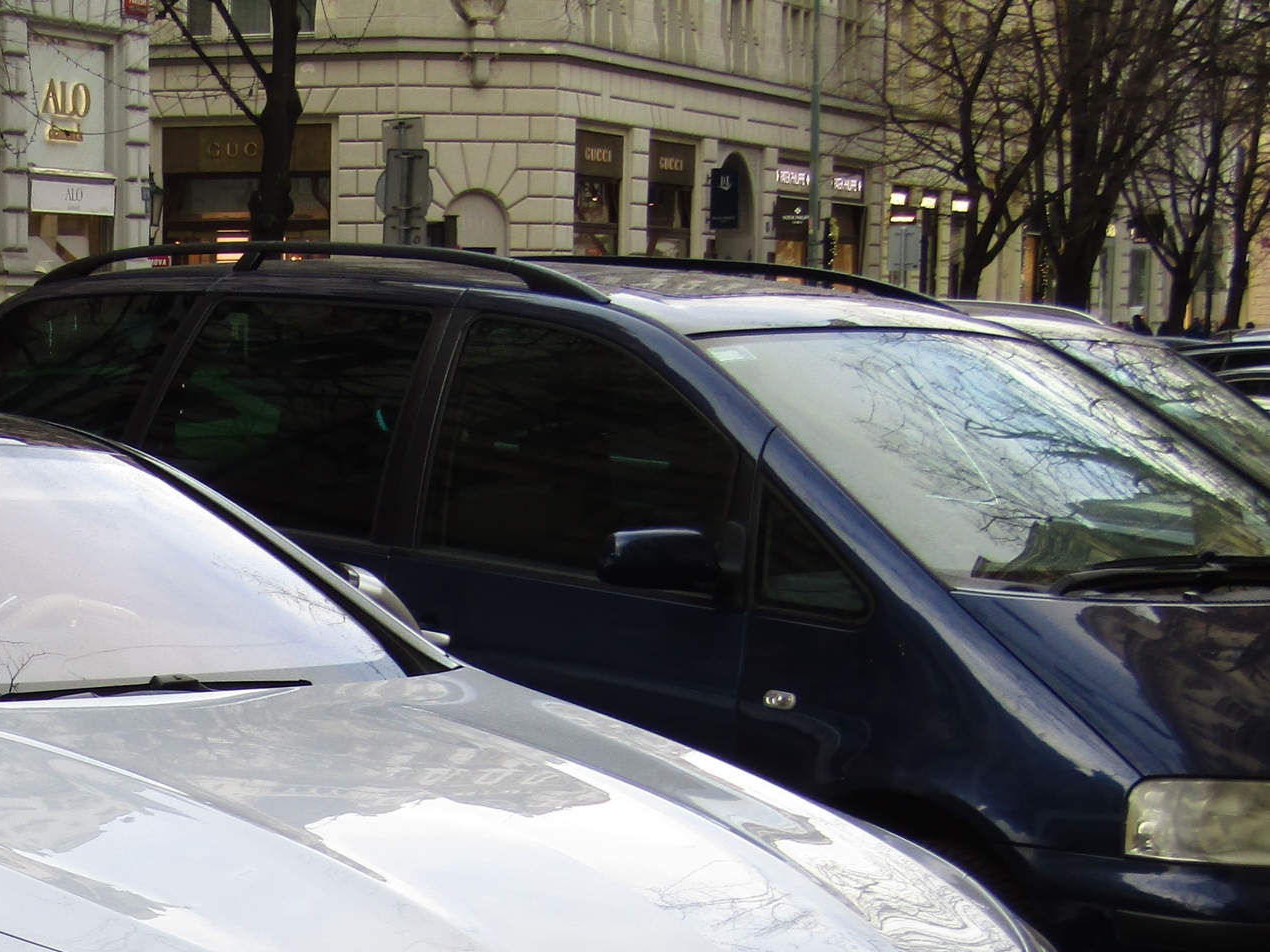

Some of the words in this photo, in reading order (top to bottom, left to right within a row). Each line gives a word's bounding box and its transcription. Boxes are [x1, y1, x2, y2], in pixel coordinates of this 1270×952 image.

[42, 79, 91, 118] ALO
[207, 142, 258, 158] GUC
[584, 146, 612, 163] GUCCI
[659, 156, 683, 172] GUCCI
[65, 187, 84, 202] ALO
